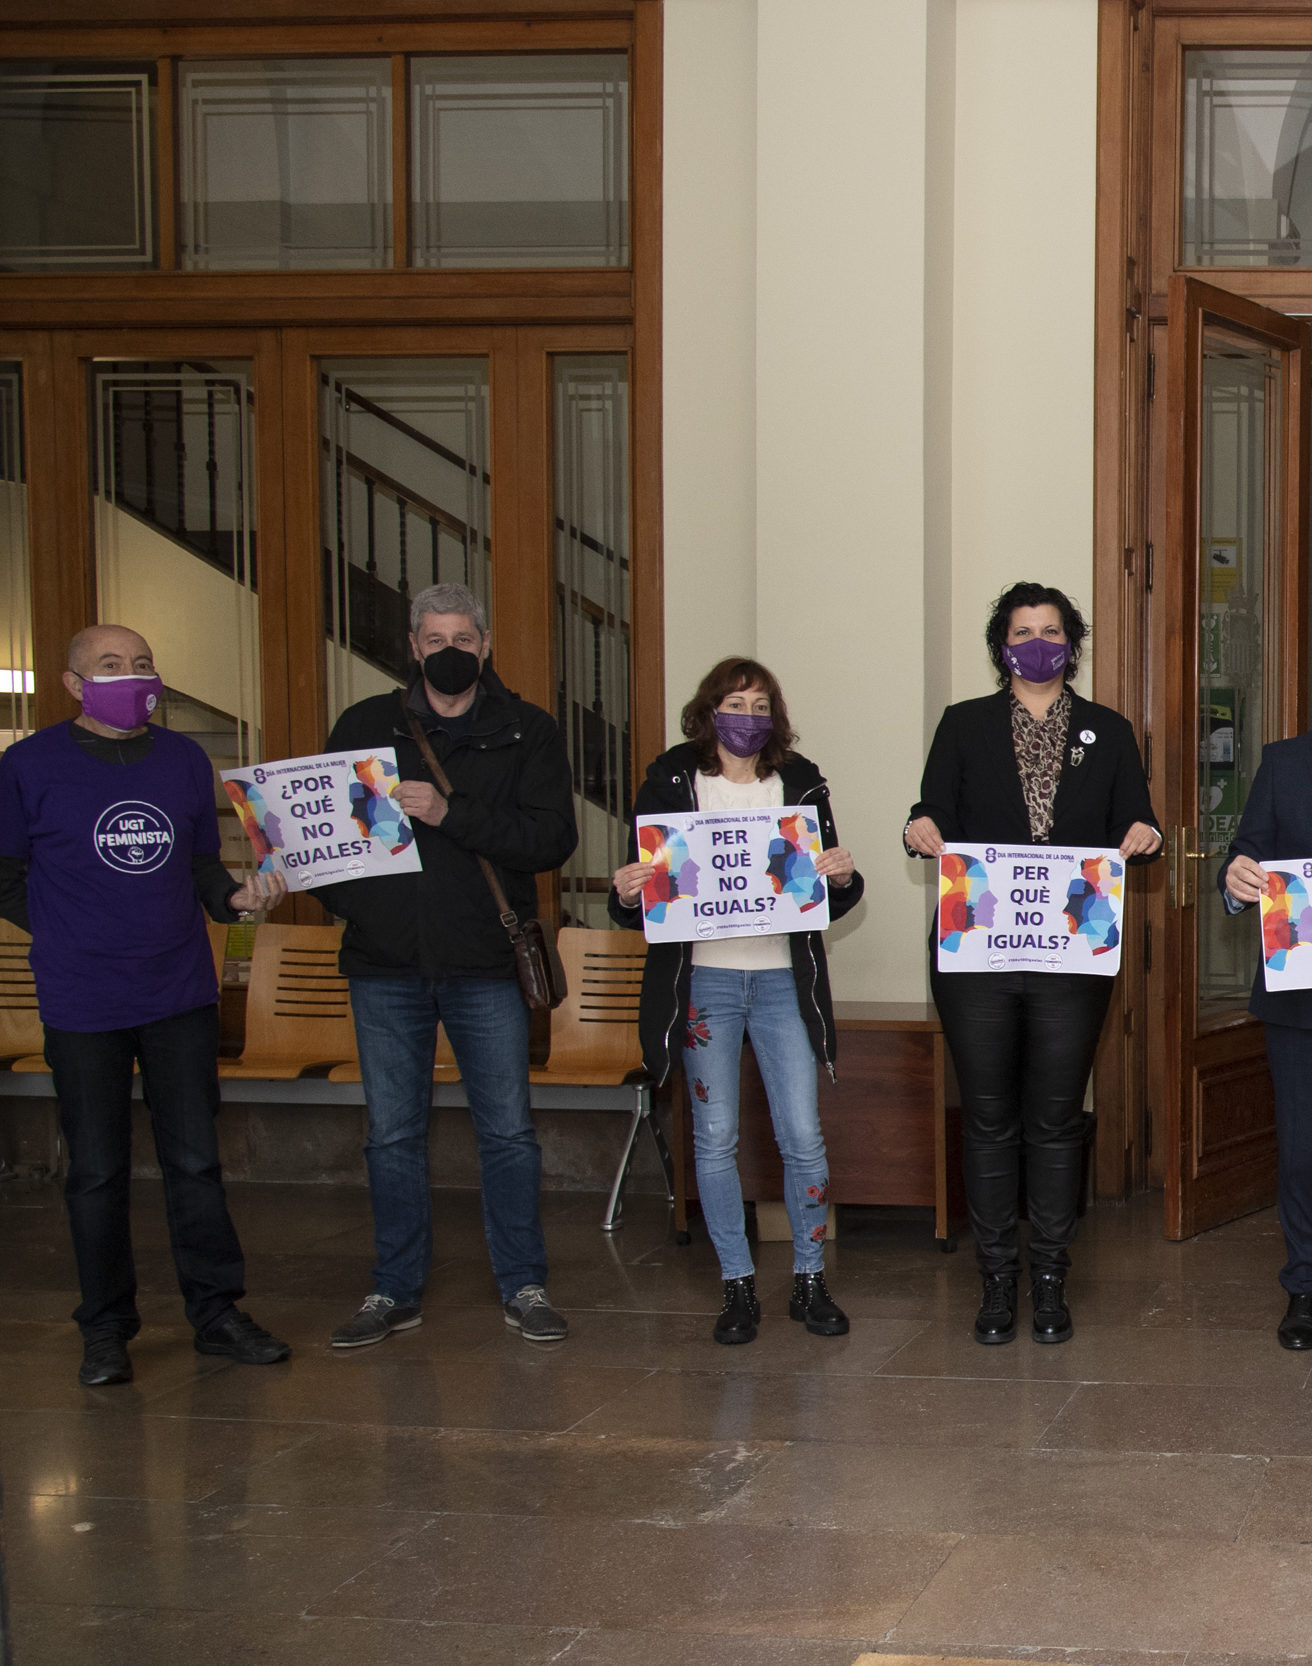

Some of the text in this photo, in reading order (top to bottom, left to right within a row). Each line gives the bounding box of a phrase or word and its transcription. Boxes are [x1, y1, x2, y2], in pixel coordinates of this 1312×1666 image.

[281, 775, 334, 800] ¿POR
[291, 795, 335, 819] QUÉ
[119, 819, 145, 831] UGT
[301, 822, 334, 841] NO
[98, 831, 171, 847] FEMINISTA
[711, 829, 749, 846] PER
[281, 840, 372, 869] IGUALES?
[711, 850, 752, 871] QUÈ
[1012, 865, 1050, 881] PER
[718, 876, 748, 892] NO
[1010, 886, 1051, 906] QUÈ
[693, 897, 776, 917] IGUALS?
[1015, 911, 1045, 926] NO
[987, 934, 1071, 950] IGUALS?
